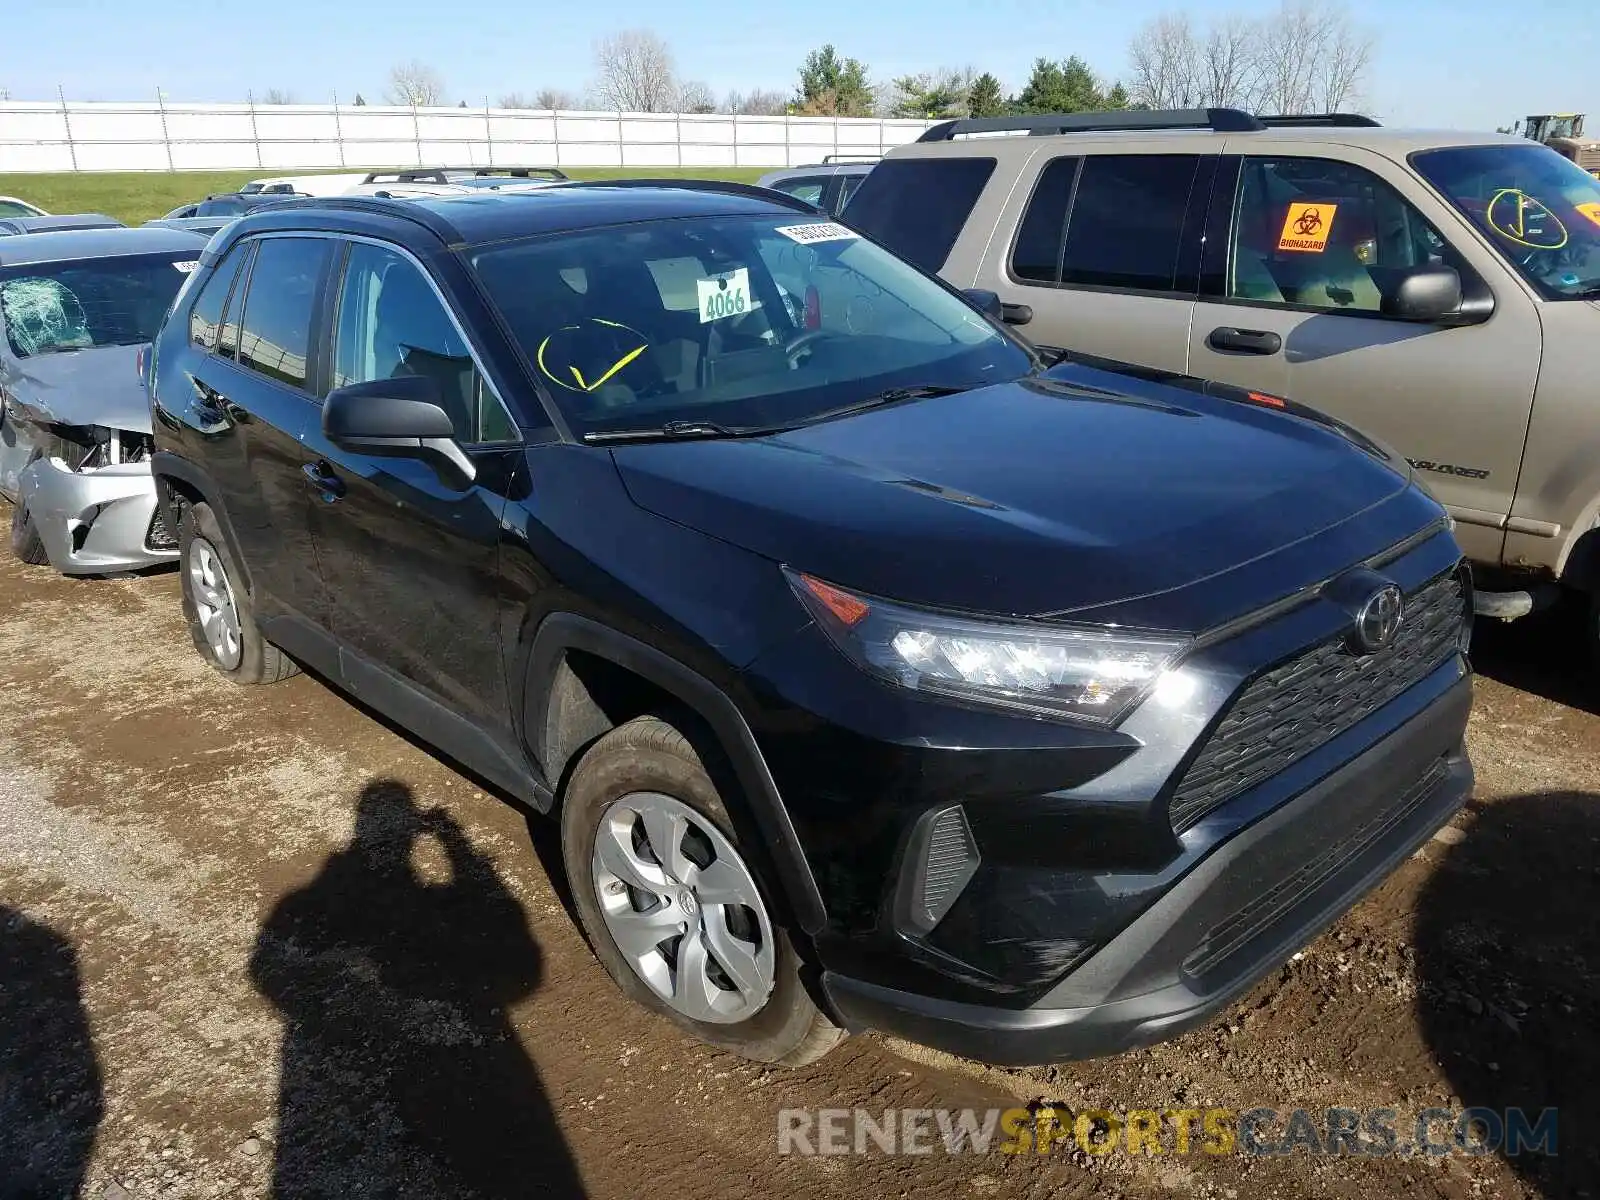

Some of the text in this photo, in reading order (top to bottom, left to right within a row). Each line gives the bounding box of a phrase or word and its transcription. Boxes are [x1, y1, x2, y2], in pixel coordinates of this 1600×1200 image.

[1280, 239, 1325, 250] BIOHAZARD
[706, 287, 745, 319] 4066
[1404, 457, 1490, 479] XPLORER
